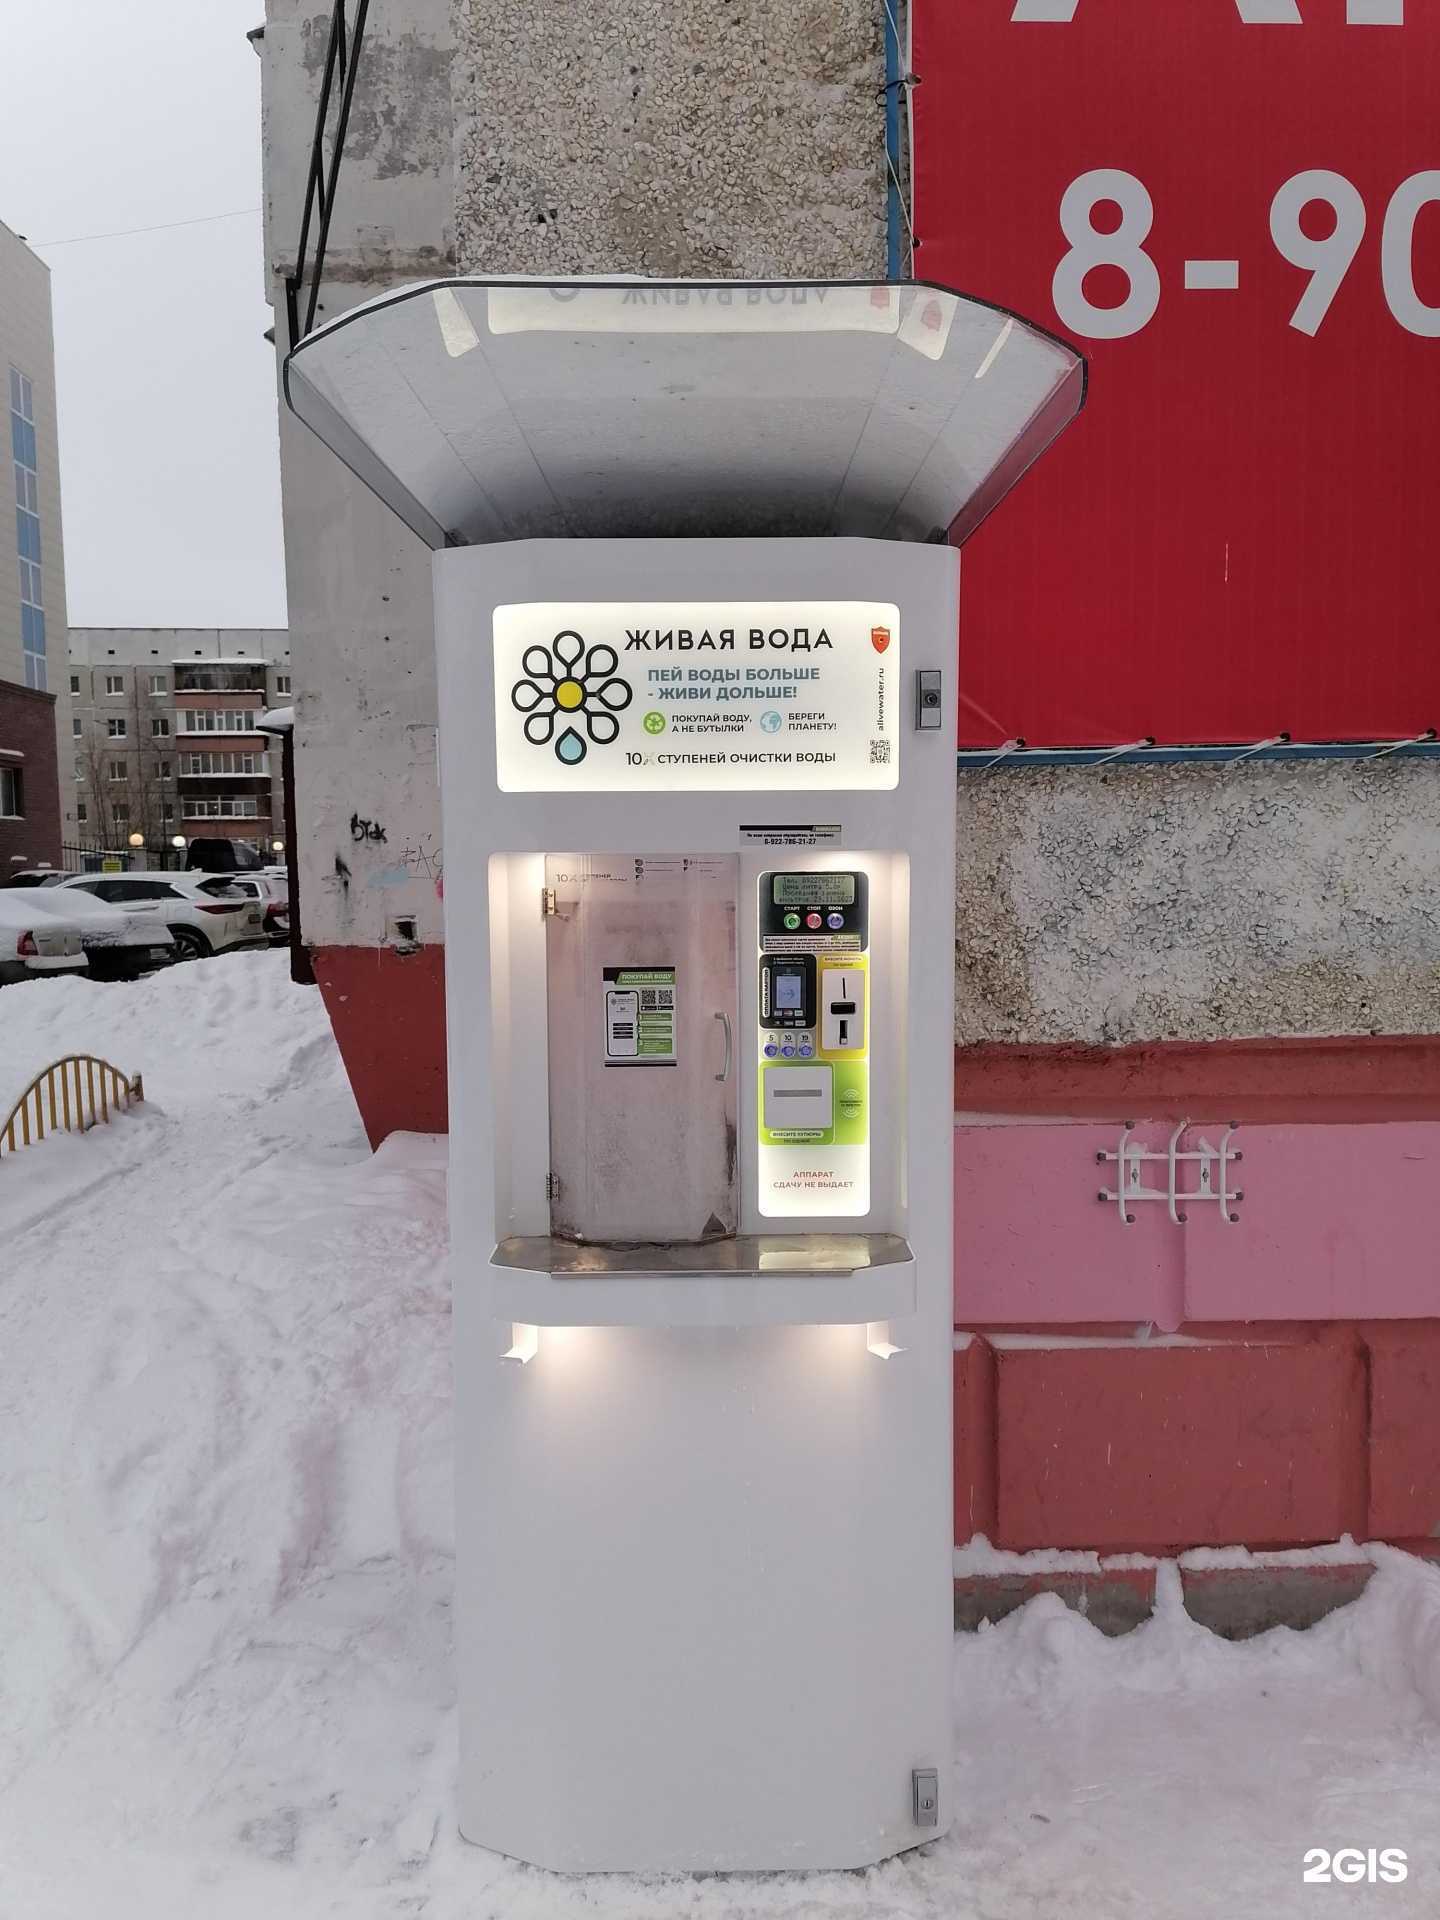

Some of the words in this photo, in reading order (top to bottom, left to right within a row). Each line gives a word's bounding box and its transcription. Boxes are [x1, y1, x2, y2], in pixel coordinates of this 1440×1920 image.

[624, 629, 736, 652] ЖИВАЯ
[749, 628, 834, 652] ВОДА
[647, 667, 684, 682] ПЕЙ
[687, 668, 743, 684] ВОДЫ
[745, 667, 820, 682] БОЛЬШЕ
[657, 686, 712, 700] ЖИВИ
[715, 686, 798, 702] ДОЛЬШЕ!
[876, 667, 886, 732] alivewater.ru
[671, 712, 721, 724] ПОКУПАЙ
[722, 713, 753, 726] ВОДУ,
[787, 712, 826, 721] БЕРЕГИ
[671, 725, 680, 733] А
[681, 724, 696, 733] НЕ
[697, 723, 746, 733] БУТЫЛКИ
[787, 722, 837, 732] ПЛАНЕТУ!
[657, 751, 725, 765] СТУПЕНЕЙ
[729, 752, 792, 764] ОЧИСТКИ
[796, 752, 836, 764] ВОДЫ
[773, 1181, 802, 1189] СДАЧУ
[817, 1181, 854, 1189] ВЫДАЕТ
